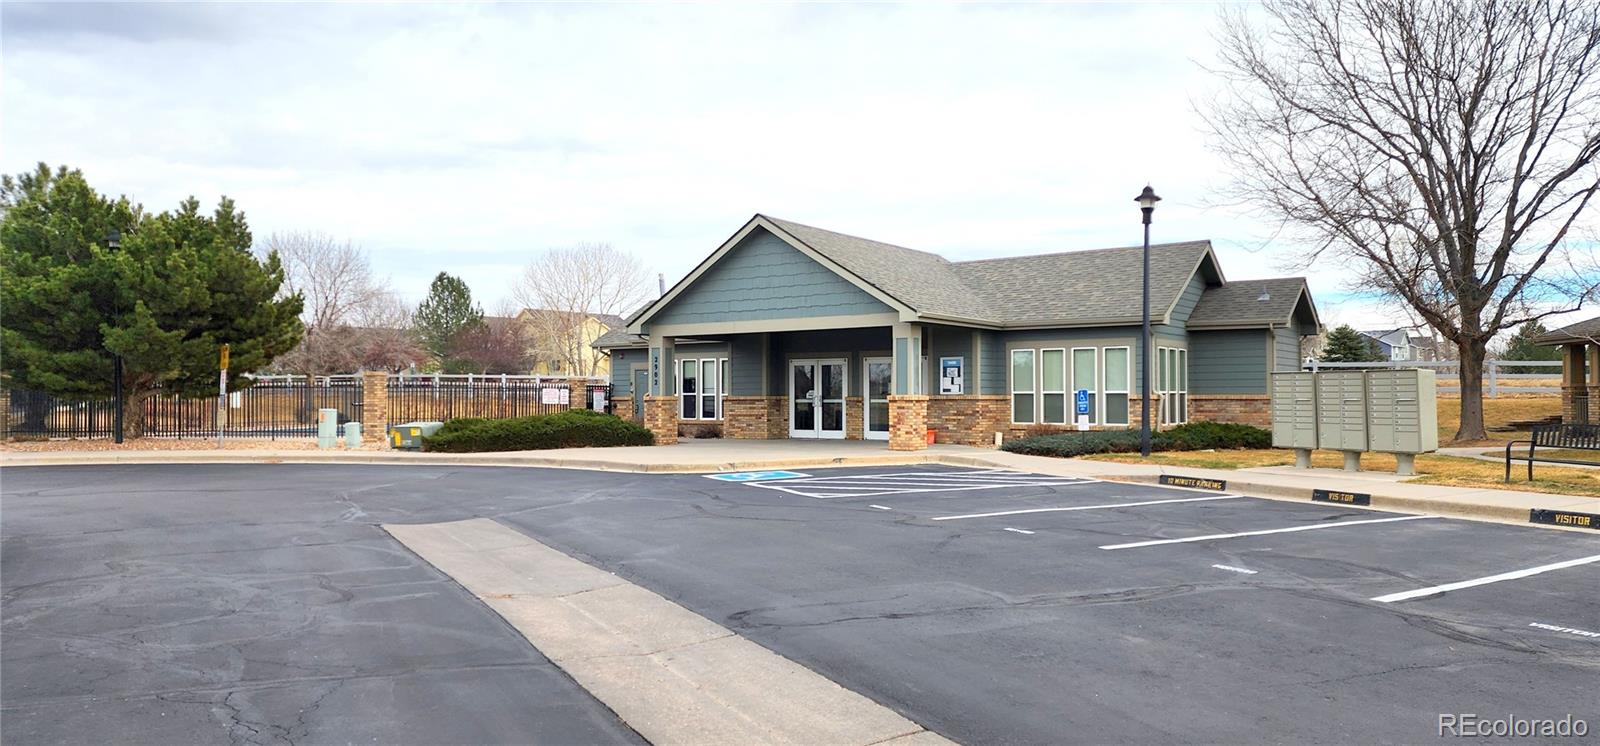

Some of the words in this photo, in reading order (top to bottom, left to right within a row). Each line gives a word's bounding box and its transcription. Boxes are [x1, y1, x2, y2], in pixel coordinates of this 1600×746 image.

[1174, 478, 1196, 487] MINUTE
[1328, 492, 1355, 502] VISTOR
[1555, 514, 1591, 526] VISITOR
